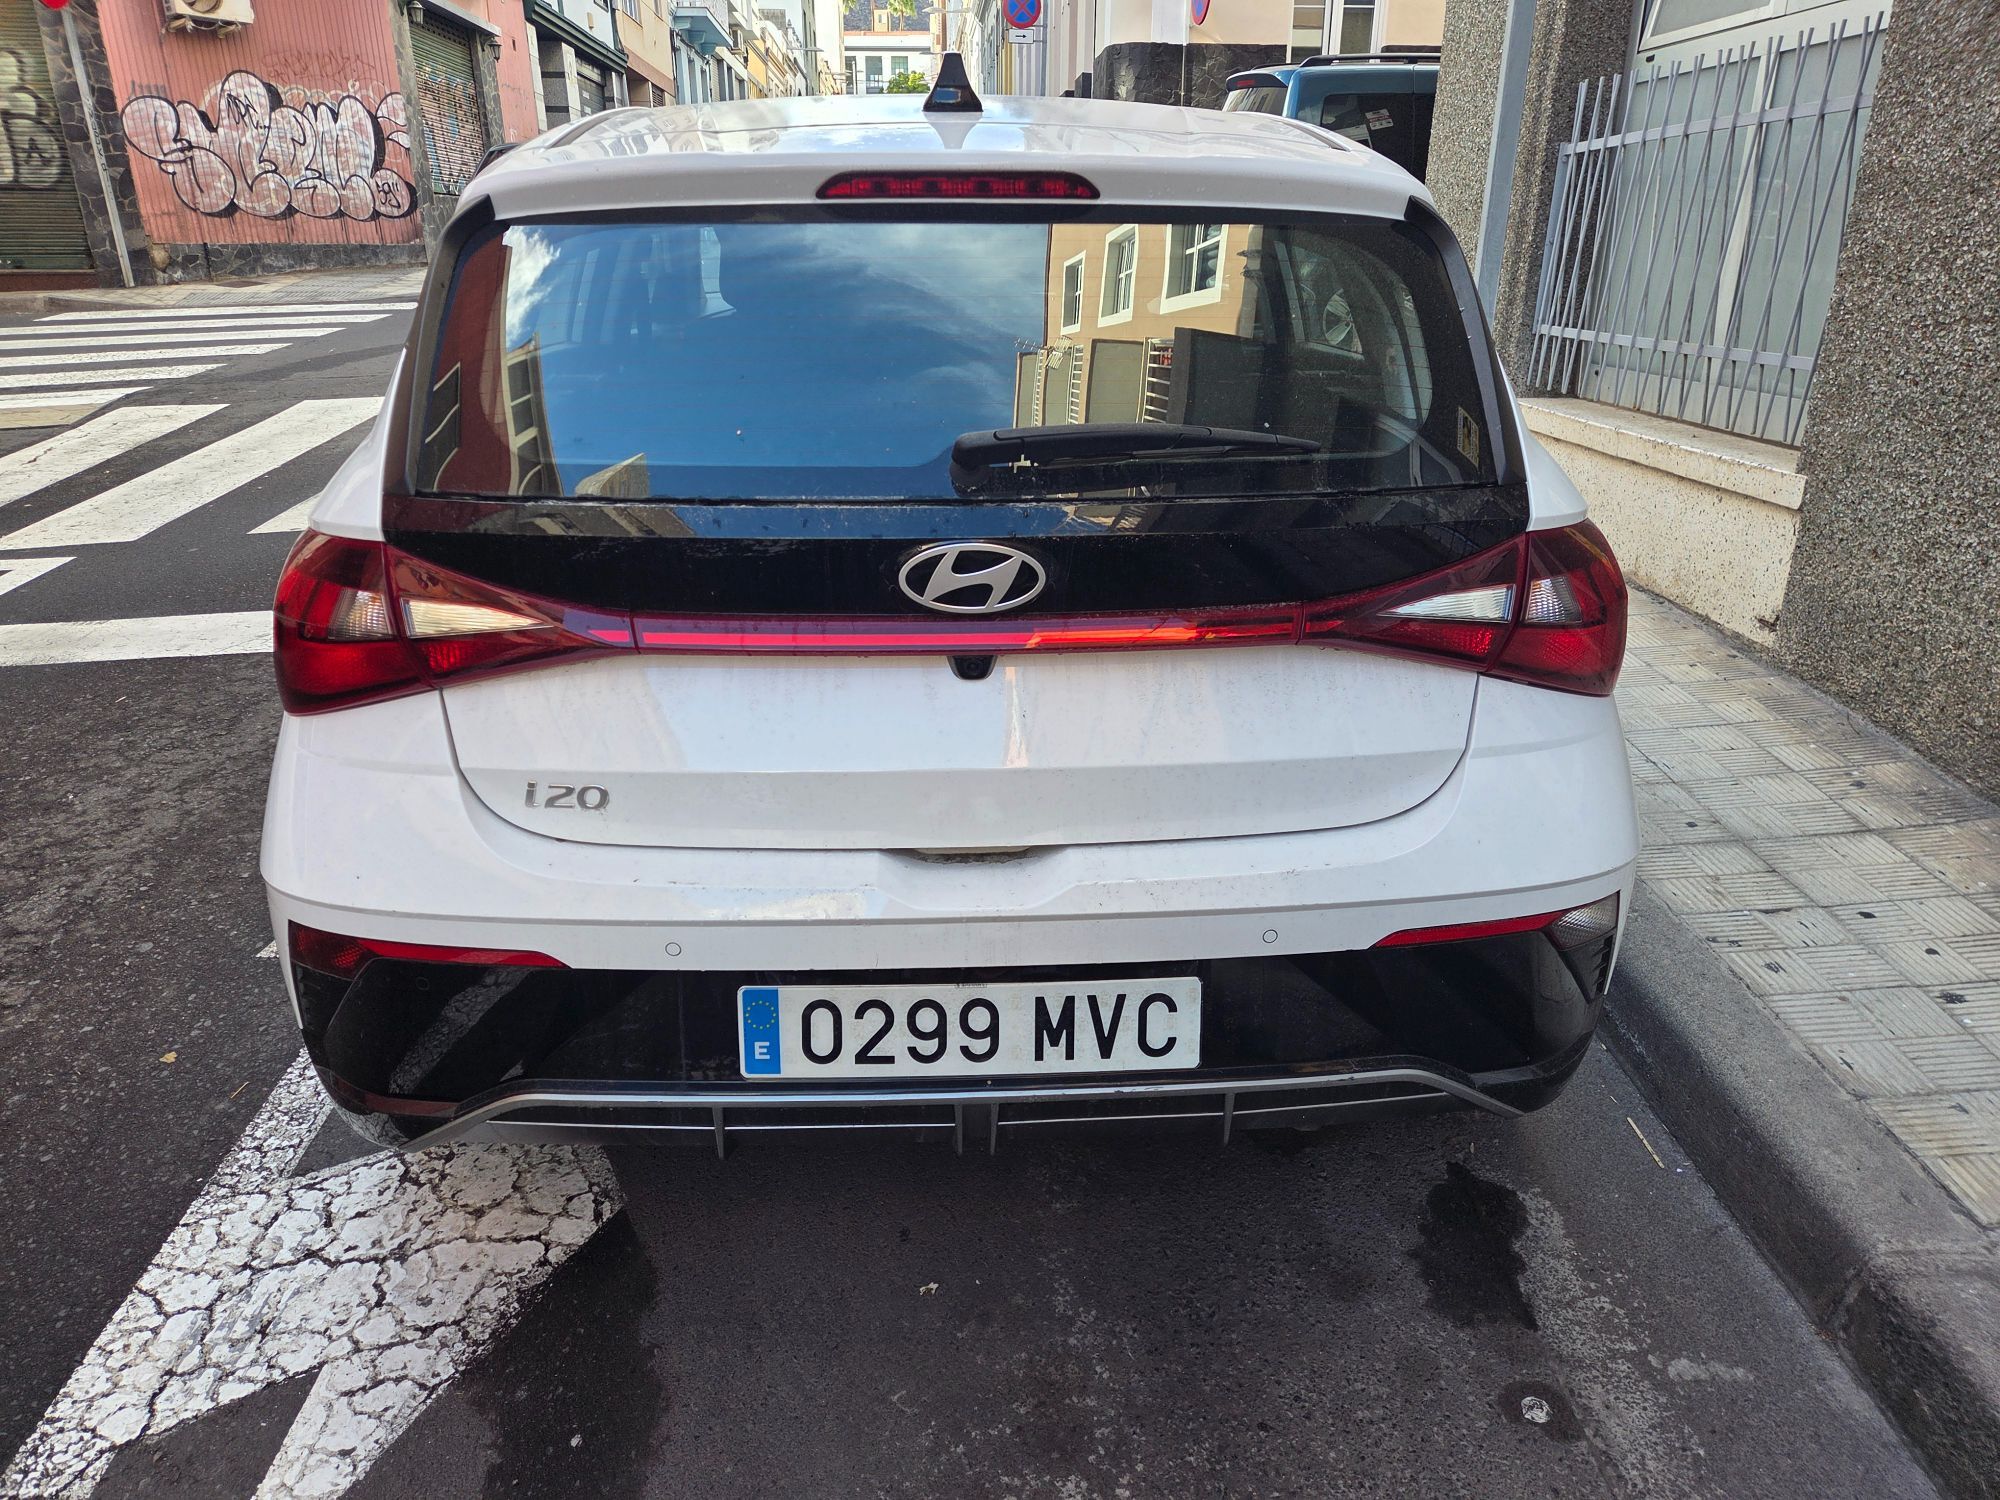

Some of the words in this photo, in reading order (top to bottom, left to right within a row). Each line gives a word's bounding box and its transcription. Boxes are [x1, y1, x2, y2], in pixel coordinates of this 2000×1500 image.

[525, 780, 610, 809] i20
[801, 998, 1000, 1065] 0299
[1034, 993, 1178, 1062] MVC
[755, 1041, 770, 1060] E
